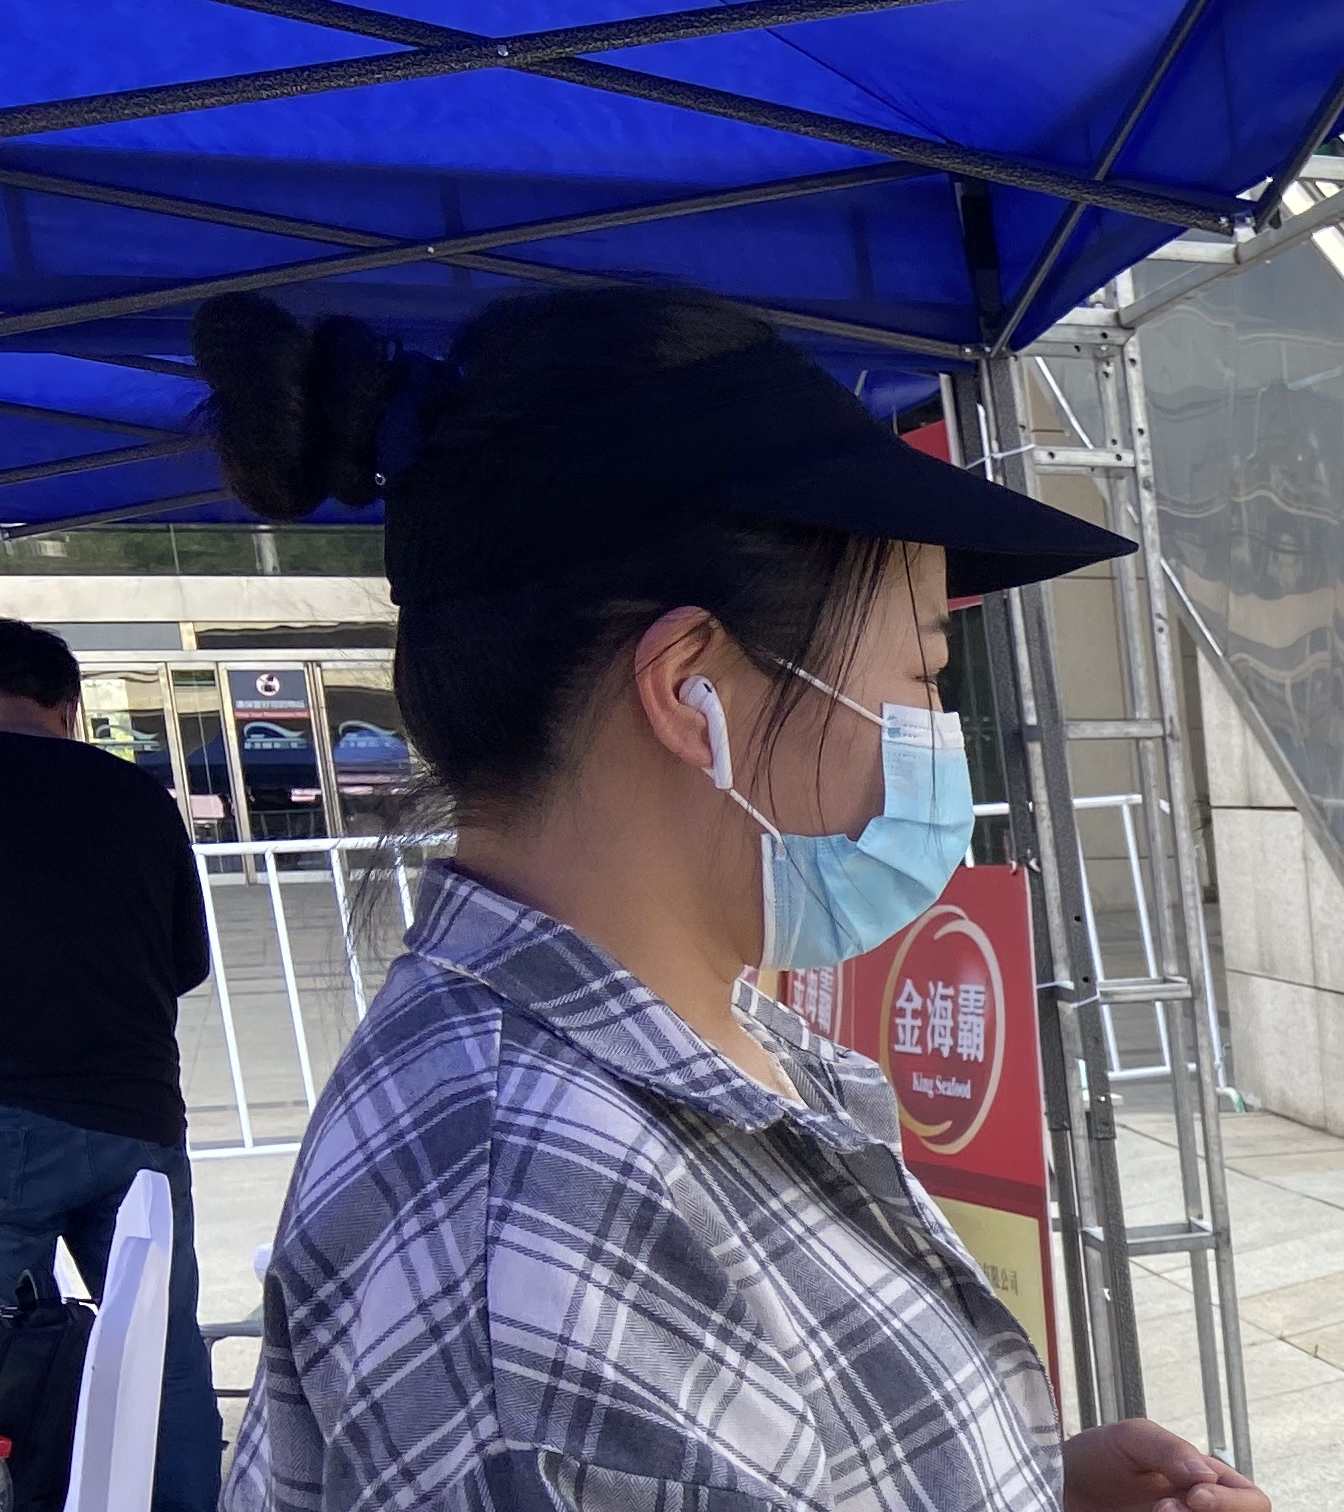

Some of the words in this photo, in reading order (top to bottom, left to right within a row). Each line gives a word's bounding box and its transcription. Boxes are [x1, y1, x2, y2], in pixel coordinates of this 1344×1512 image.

[893, 978, 985, 1063] 金海霸
[911, 1072, 933, 1097] King
[934, 1075, 972, 1100] Seafood
